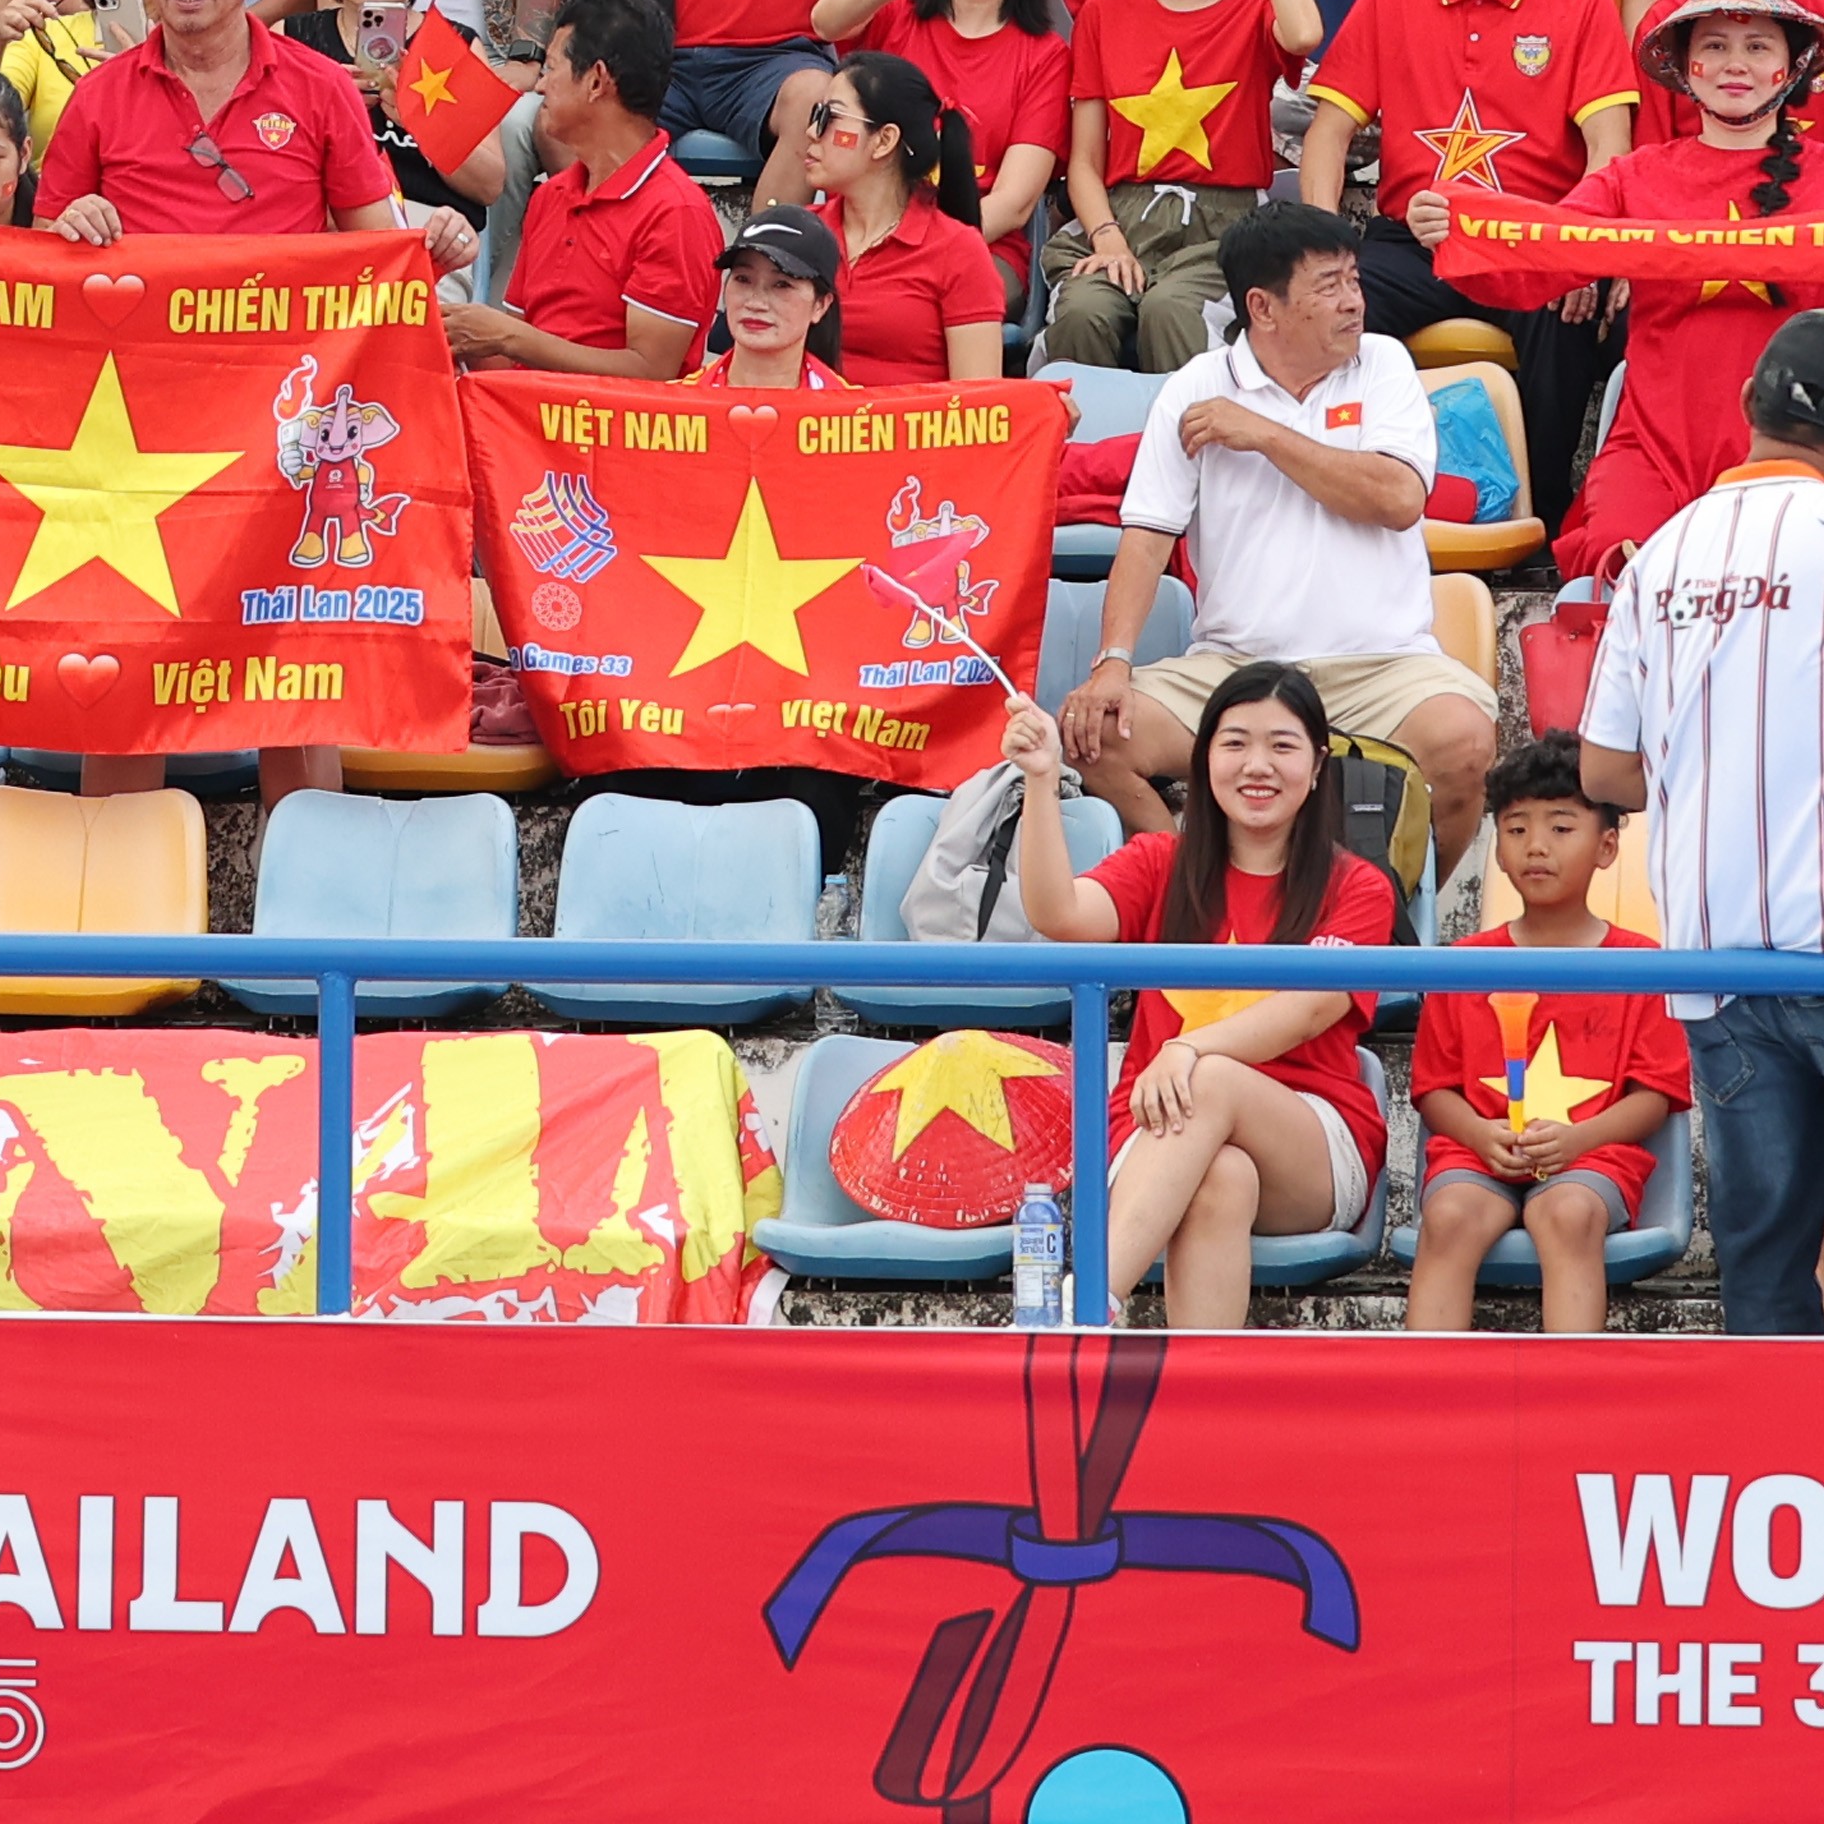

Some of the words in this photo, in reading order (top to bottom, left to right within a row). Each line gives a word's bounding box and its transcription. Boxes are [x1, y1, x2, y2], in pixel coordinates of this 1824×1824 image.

[168, 272, 290, 334] CHIẾN
[303, 265, 429, 329] THẮNG
[539, 399, 613, 454] VIỆT
[624, 410, 707, 453] NAM
[798, 403, 895, 455] CHIẾN
[904, 394, 1010, 446] THẮNG
[240, 587, 298, 626] Thái
[301, 589, 349, 624] Lan
[353, 586, 425, 626] 2025
[1742, 573, 1792, 610] Đá
[152, 660, 233, 713] Việt
[243, 655, 343, 701] Nam
[523, 645, 598, 676] Games
[601, 654, 632, 677] 33
[906, 658, 951, 685] Lan
[559, 696, 614, 740] Tôi
[620, 695, 684, 735] Yêu
[858, 710, 930, 752] Nam
[1573, 1640, 1765, 1728] THE
